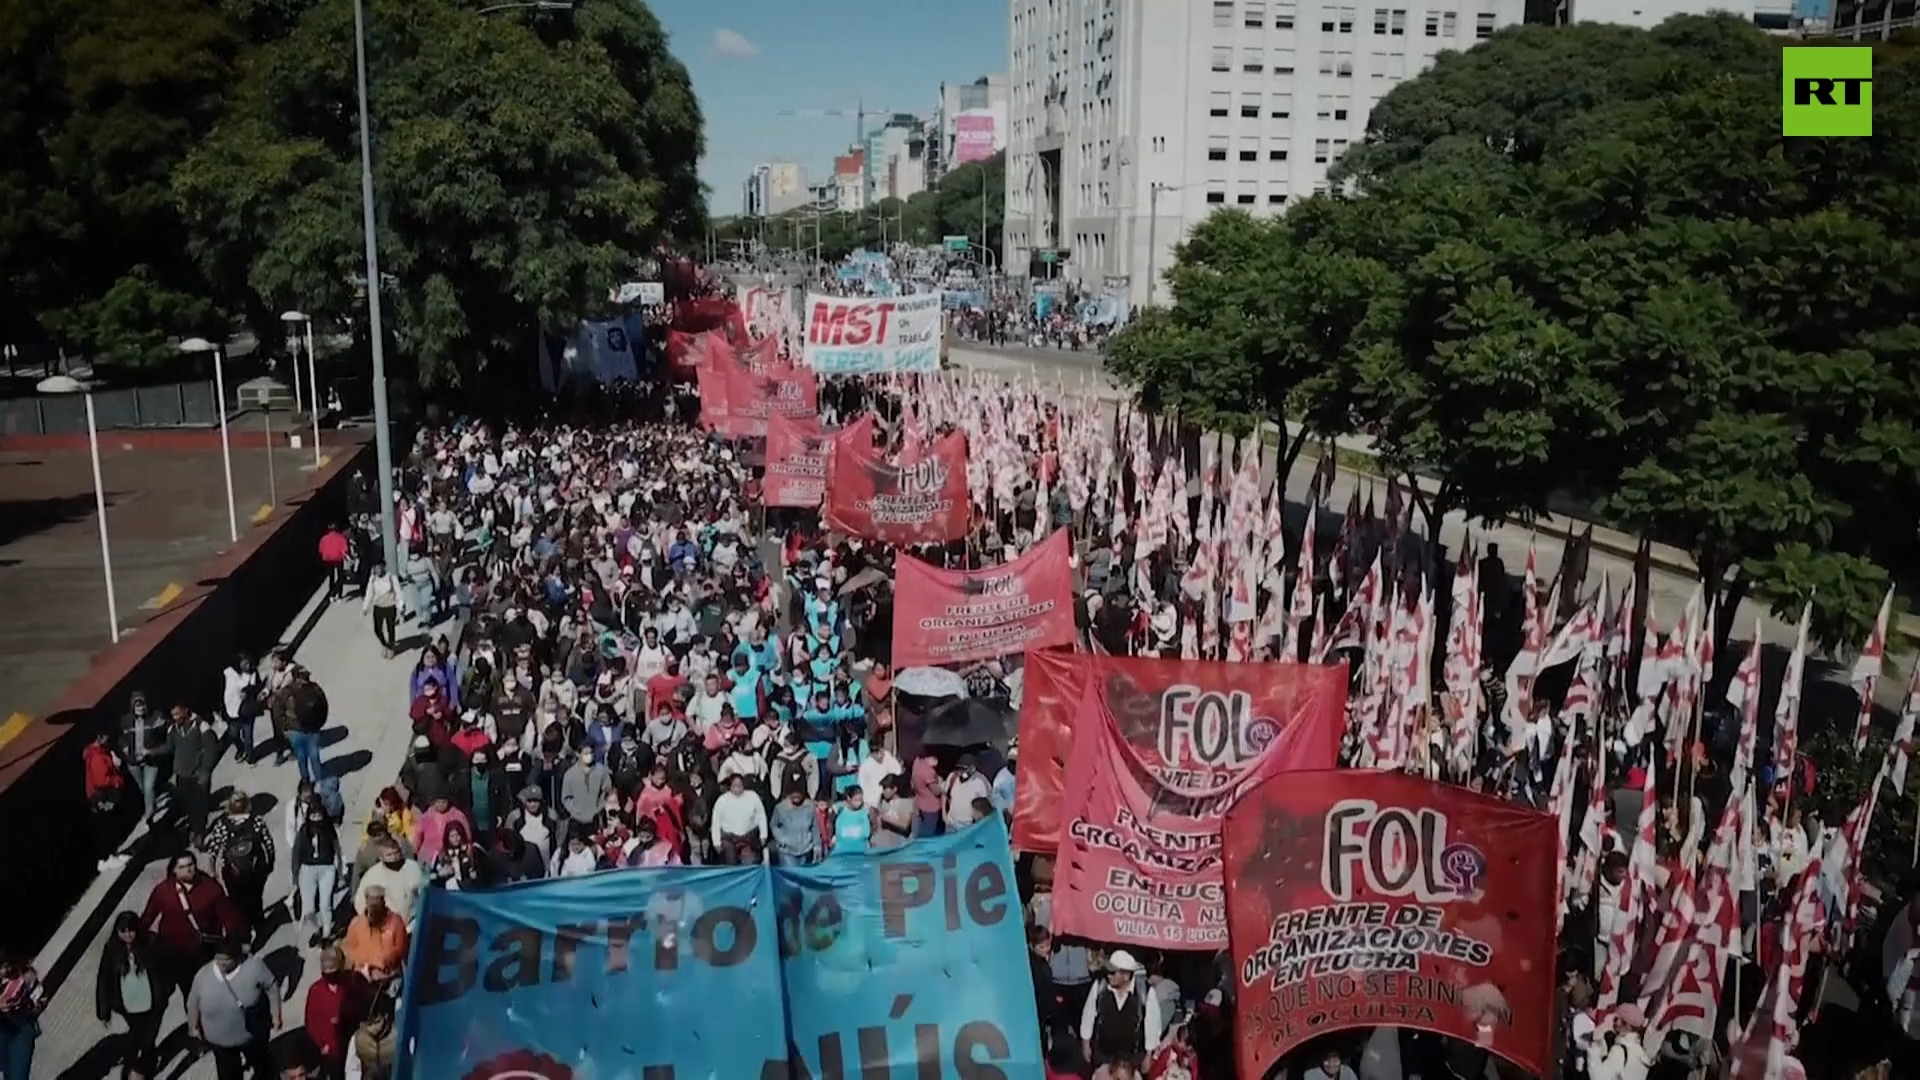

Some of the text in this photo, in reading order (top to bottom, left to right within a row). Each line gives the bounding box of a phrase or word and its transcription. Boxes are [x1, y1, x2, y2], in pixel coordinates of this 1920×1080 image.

[809, 302, 895, 346] MST
[920, 599, 1056, 629] ORGANIZACIONES
[1160, 687, 1255, 765] FOL
[1324, 803, 1453, 898] FOL
[1109, 870, 1224, 900] EN LUC
[1096, 895, 1182, 920] OCULTA
[1271, 904, 1443, 940] FRENTE DE
[418, 890, 757, 1006] Barrio
[879, 853, 1008, 938] Pie
[1116, 920, 1157, 936] VILLA
[1244, 928, 1490, 983] ORGANIZACIONES
[1273, 951, 1417, 988] EN LUCHA
[1268, 982, 1309, 1021] QUE
[1318, 976, 1355, 1001] NO
[1365, 973, 1397, 997] SE
[1306, 1003, 1435, 1027] OCULTA
